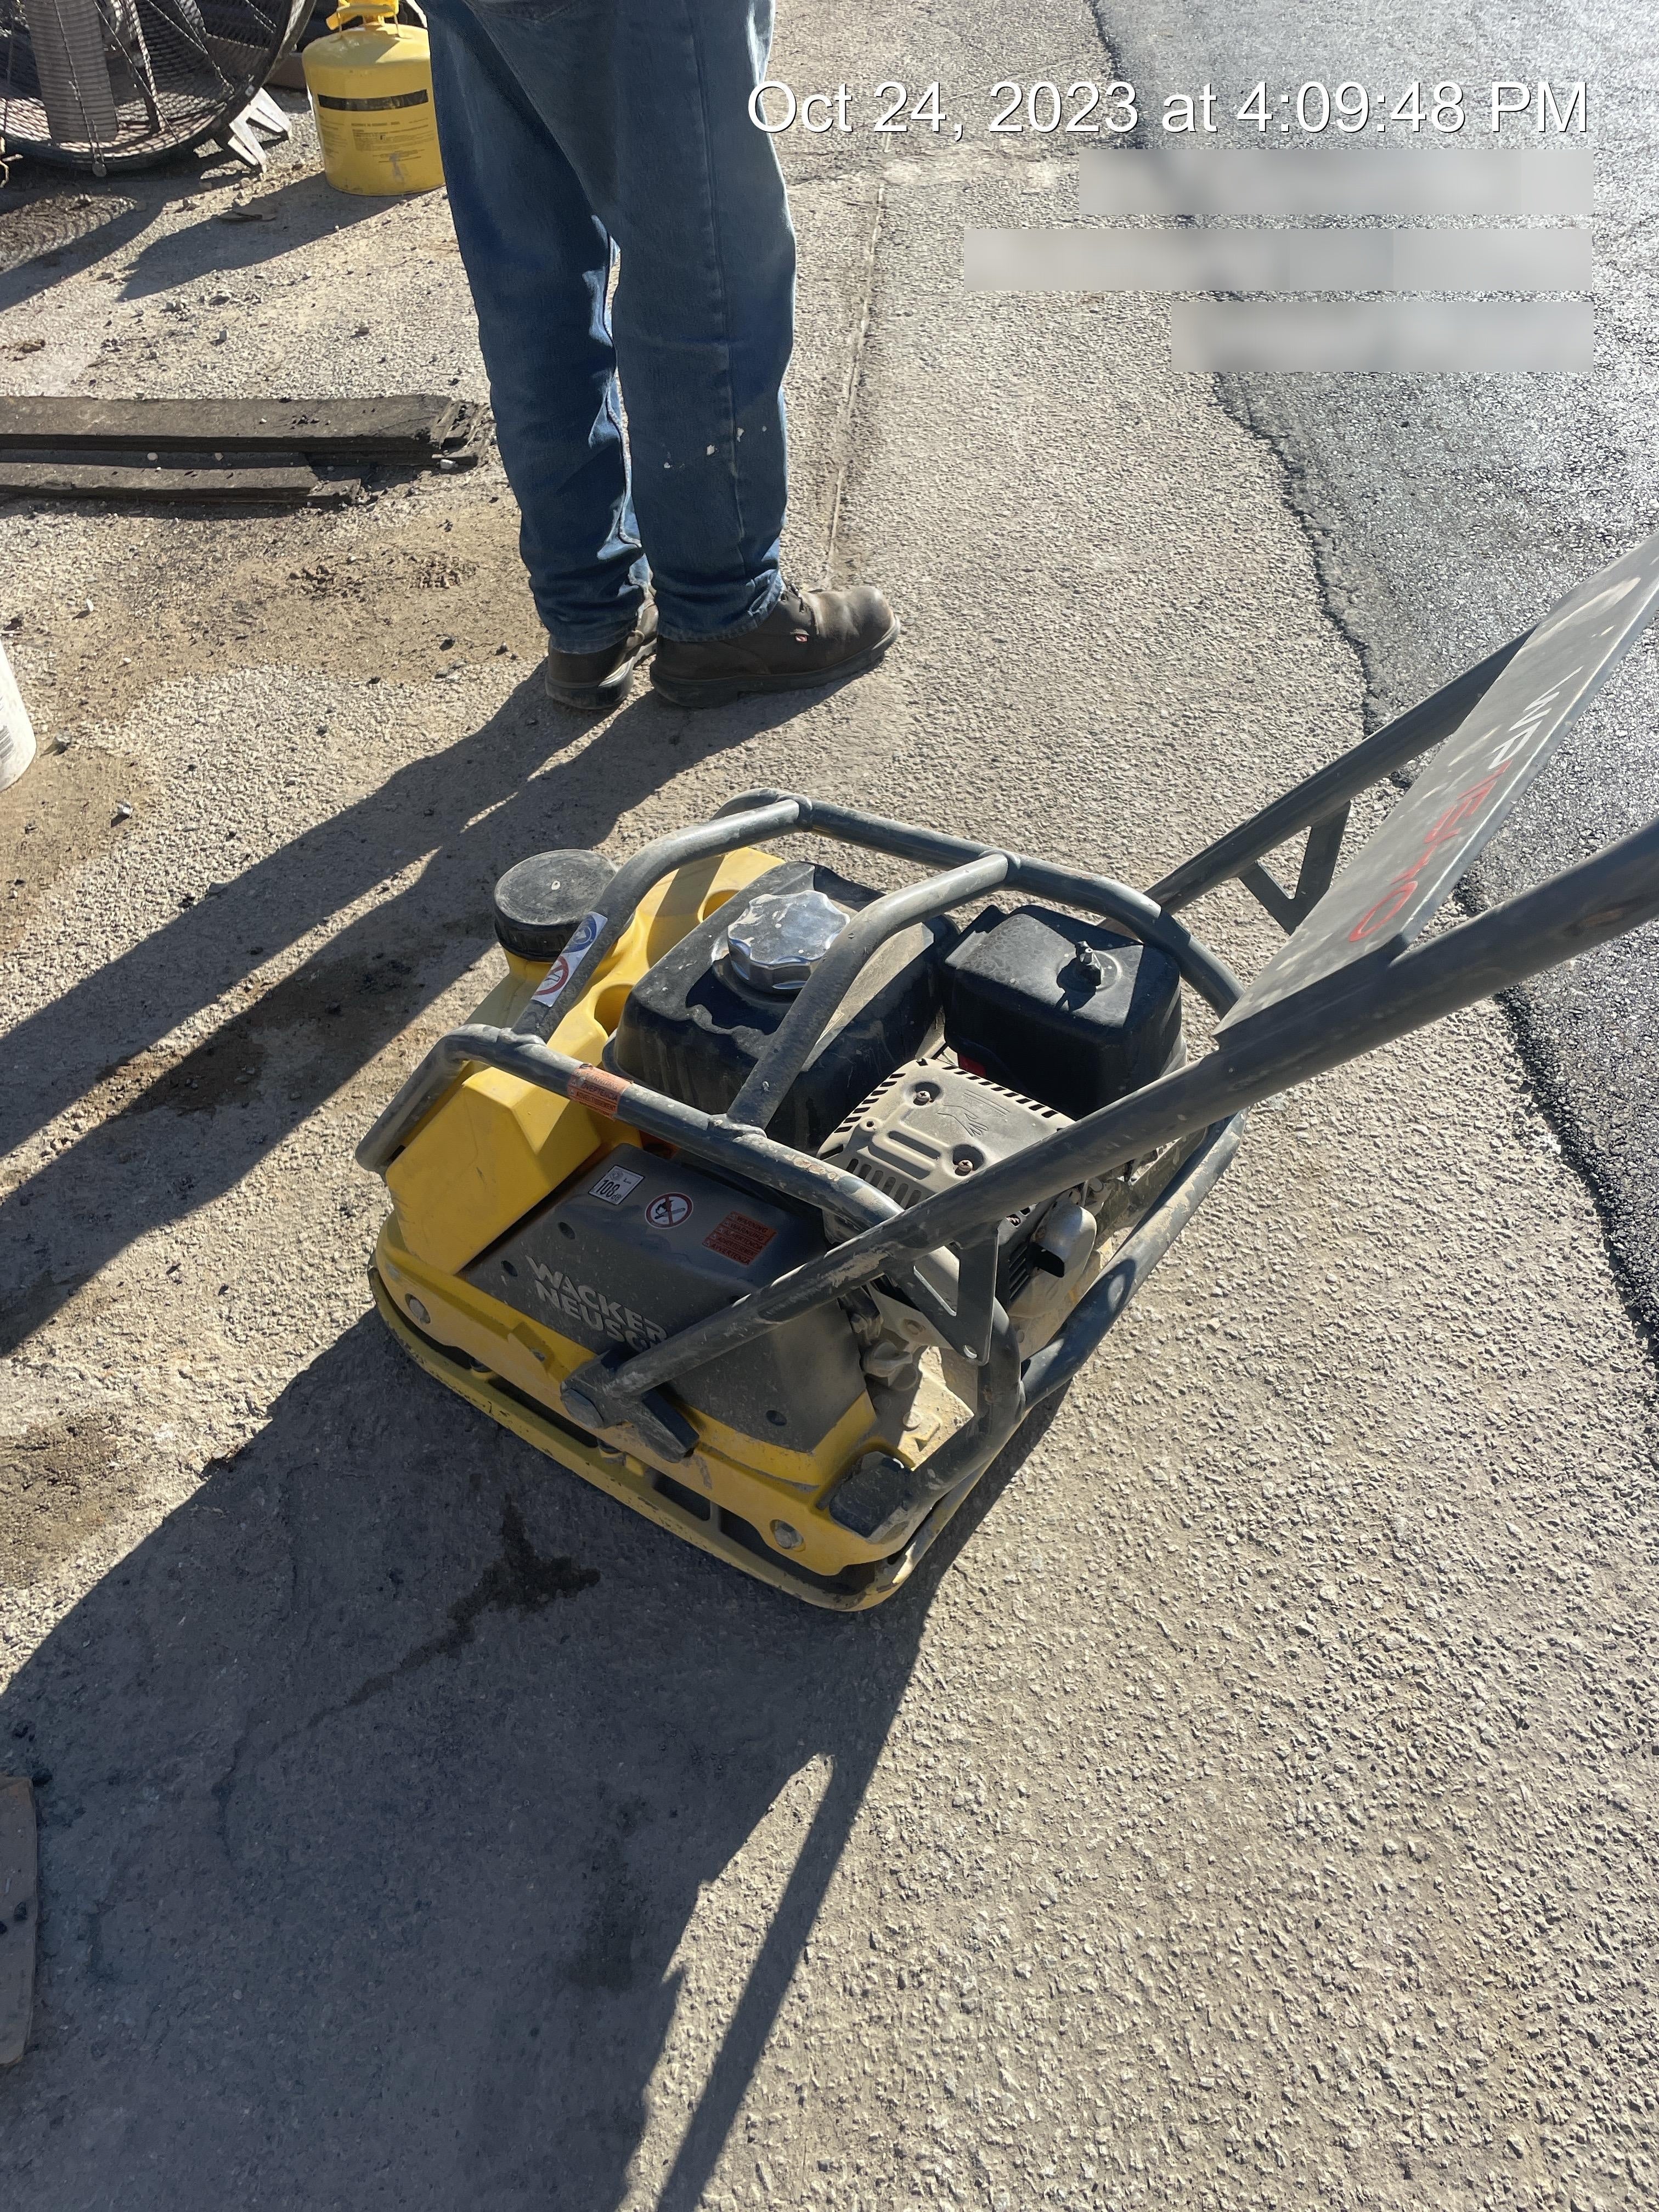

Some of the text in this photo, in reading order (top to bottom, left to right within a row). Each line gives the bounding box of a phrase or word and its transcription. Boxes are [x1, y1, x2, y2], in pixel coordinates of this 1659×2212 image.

[596, 1179, 620, 1198] 108
[730, 1223, 765, 1241] WARNUNG
[736, 1216, 769, 1233] WARNING
[525, 1255, 668, 1344] WACKER
[534, 1279, 658, 1352] NEUSO
